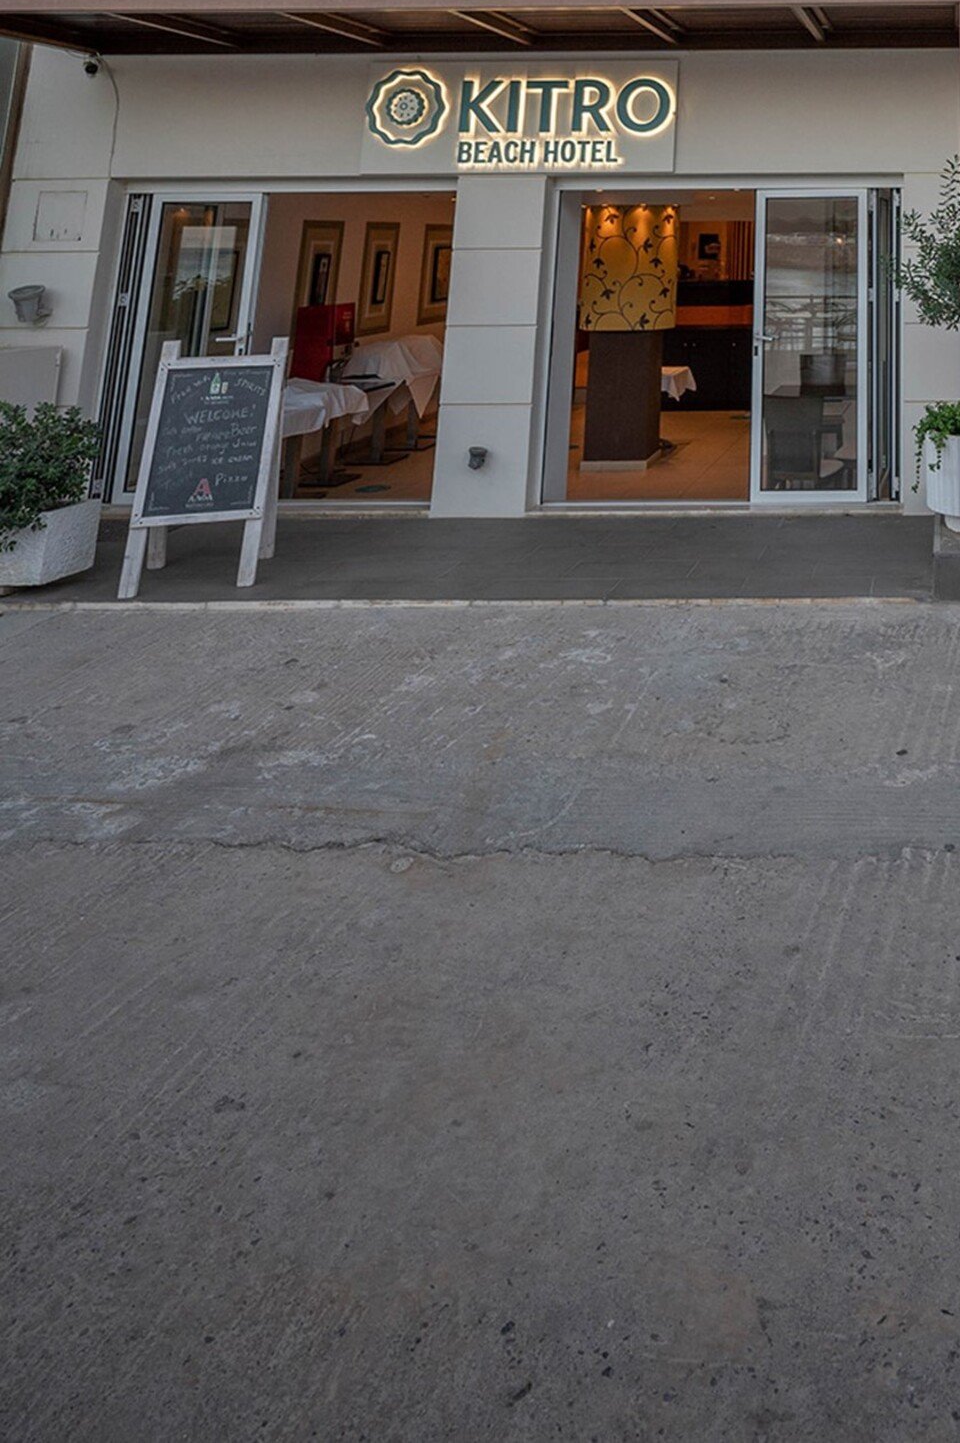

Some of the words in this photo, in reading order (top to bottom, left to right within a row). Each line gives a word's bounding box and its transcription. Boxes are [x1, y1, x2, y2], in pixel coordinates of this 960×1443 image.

[457, 77, 671, 133] KITRO
[457, 141, 536, 163] BEACH
[543, 140, 618, 163] HOTEL
